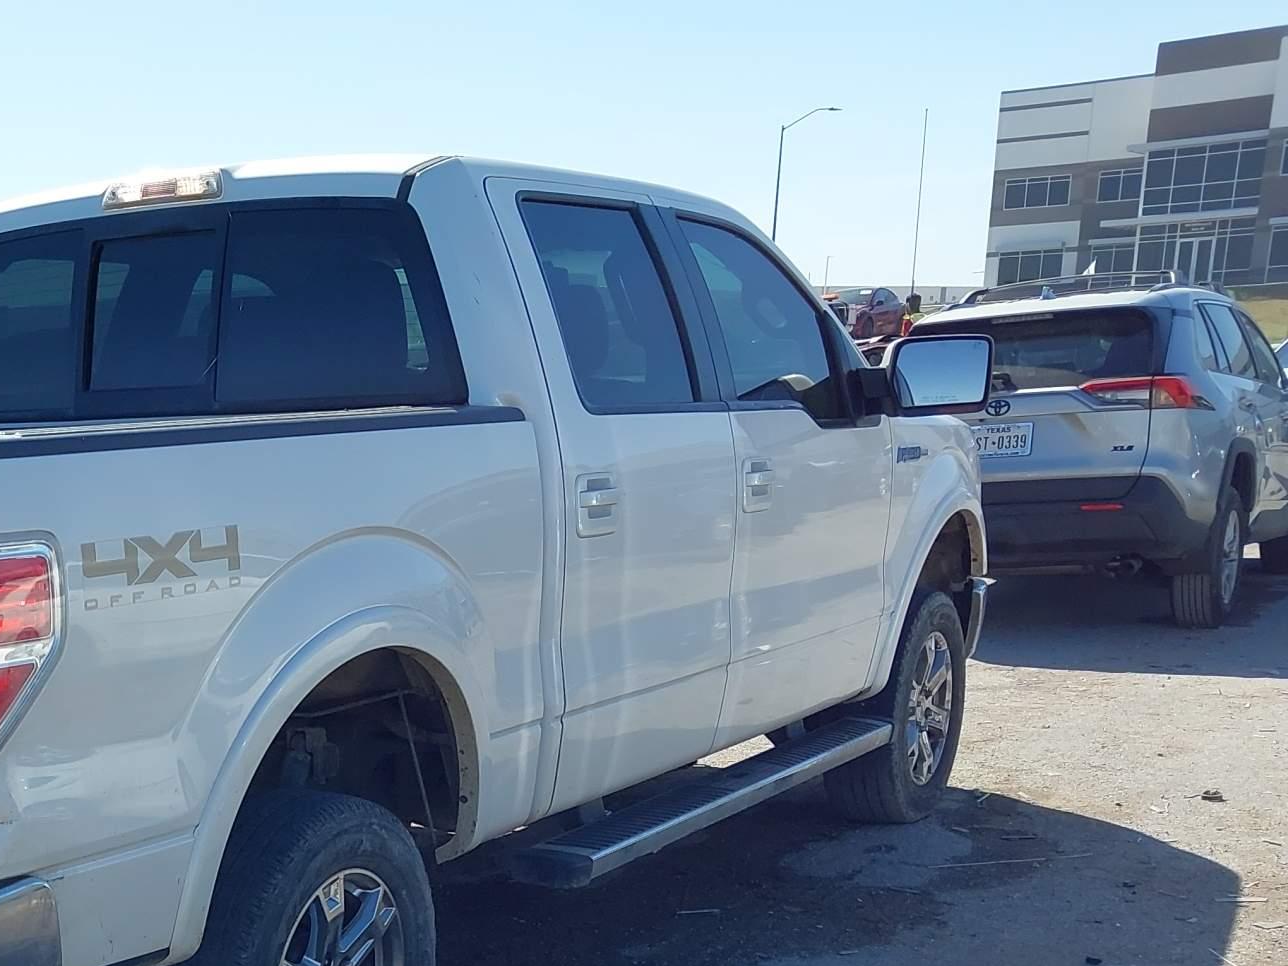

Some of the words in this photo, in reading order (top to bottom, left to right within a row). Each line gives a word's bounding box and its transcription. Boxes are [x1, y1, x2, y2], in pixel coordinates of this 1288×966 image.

[985, 426, 1012, 434] TEXAS
[84, 590, 145, 612] OFF
[161, 575, 241, 600] ROAD
